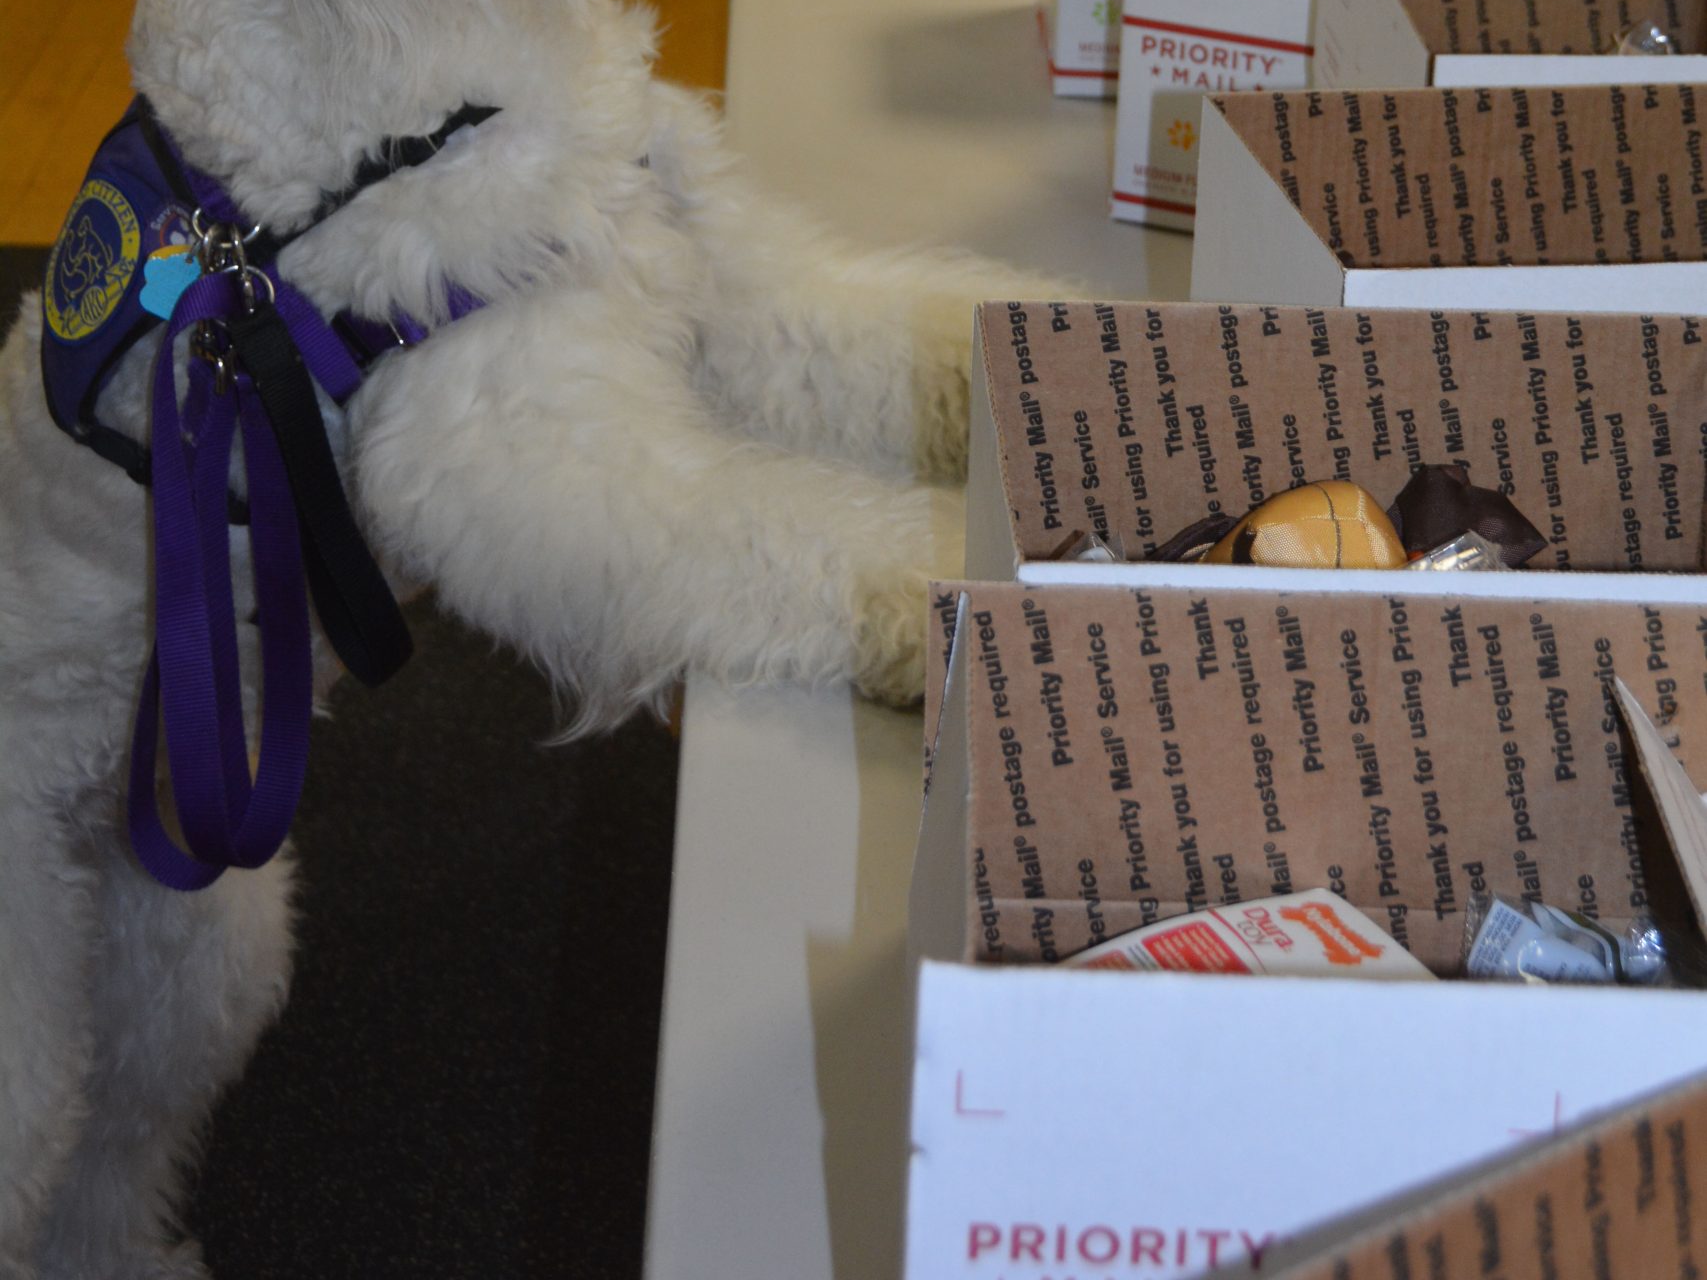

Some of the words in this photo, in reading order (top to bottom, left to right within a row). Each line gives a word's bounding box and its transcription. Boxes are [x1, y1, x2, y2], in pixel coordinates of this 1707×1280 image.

[1141, 35, 1276, 76] PRIORITY
[1172, 67, 1240, 91] MAIL
[1272, 93, 1296, 163] postage
[1382, 94, 1397, 122] for
[1442, 88, 1465, 158] postage
[1551, 90, 1565, 117] for
[1555, 121, 1574, 156] you
[1610, 86, 1632, 155] postage
[1353, 138, 1372, 204] Priority
[1387, 126, 1406, 160] you
[1519, 133, 1539, 200] Priority
[1685, 128, 1705, 196] Priority
[1323, 182, 1343, 250] Service
[1391, 162, 1411, 220] Thank
[1415, 173, 1438, 248] required
[1490, 177, 1510, 244] Service
[1557, 156, 1577, 215] Thank
[1582, 169, 1604, 244] required
[1656, 173, 1675, 241] Service
[1364, 208, 1381, 257] using
[1530, 202, 1548, 252] using
[1007, 301, 1038, 385] postage
[1145, 308, 1164, 341] for
[1218, 305, 1249, 389] postage
[1355, 313, 1373, 346] for
[1430, 310, 1459, 393] postage
[1566, 318, 1584, 350] for
[1641, 315, 1667, 396] postage
[1108, 358, 1136, 439] Priority
[1152, 346, 1176, 387] you
[1361, 349, 1385, 390] you
[1570, 354, 1594, 394] you
[1157, 389, 1185, 458] Thank
[1318, 362, 1345, 442] Priority
[1366, 393, 1392, 462] Thank
[1528, 367, 1555, 447] Priority
[1575, 396, 1600, 465] Thank
[1073, 409, 1100, 492] Service
[1125, 442, 1147, 501] using
[1186, 404, 1218, 495] required
[1491, 418, 1515, 496] Service
[1541, 450, 1562, 508] using
[1604, 412, 1633, 502] required
[1034, 451, 1062, 530] Priority
[1135, 506, 1155, 538] for
[1658, 462, 1684, 540] Priority
[1550, 513, 1567, 545] for
[973, 610, 1011, 718] required
[1087, 622, 1118, 719] Service
[1187, 598, 1220, 680] Thank
[1223, 617, 1262, 725] required
[1440, 604, 1472, 688] Thank
[1149, 662, 1175, 733] using
[1340, 628, 1370, 725] Service
[1400, 668, 1426, 739] using
[1476, 624, 1515, 732] required
[1040, 671, 1073, 768] Priority
[1292, 678, 1324, 773] Priority
[1540, 686, 1577, 782] Priority
[999, 727, 1036, 828] postage
[1164, 740, 1183, 778] for
[1251, 733, 1286, 834] postage
[1413, 747, 1434, 785] for
[1501, 741, 1538, 842] postage
[1171, 785, 1197, 831] you
[1420, 791, 1448, 837] you
[1119, 799, 1152, 892] Priority
[1176, 835, 1207, 913] Thank
[1369, 805, 1400, 898] Priority
[1426, 842, 1457, 920] Thank
[967, 1221, 1274, 1272] PRIORITY
